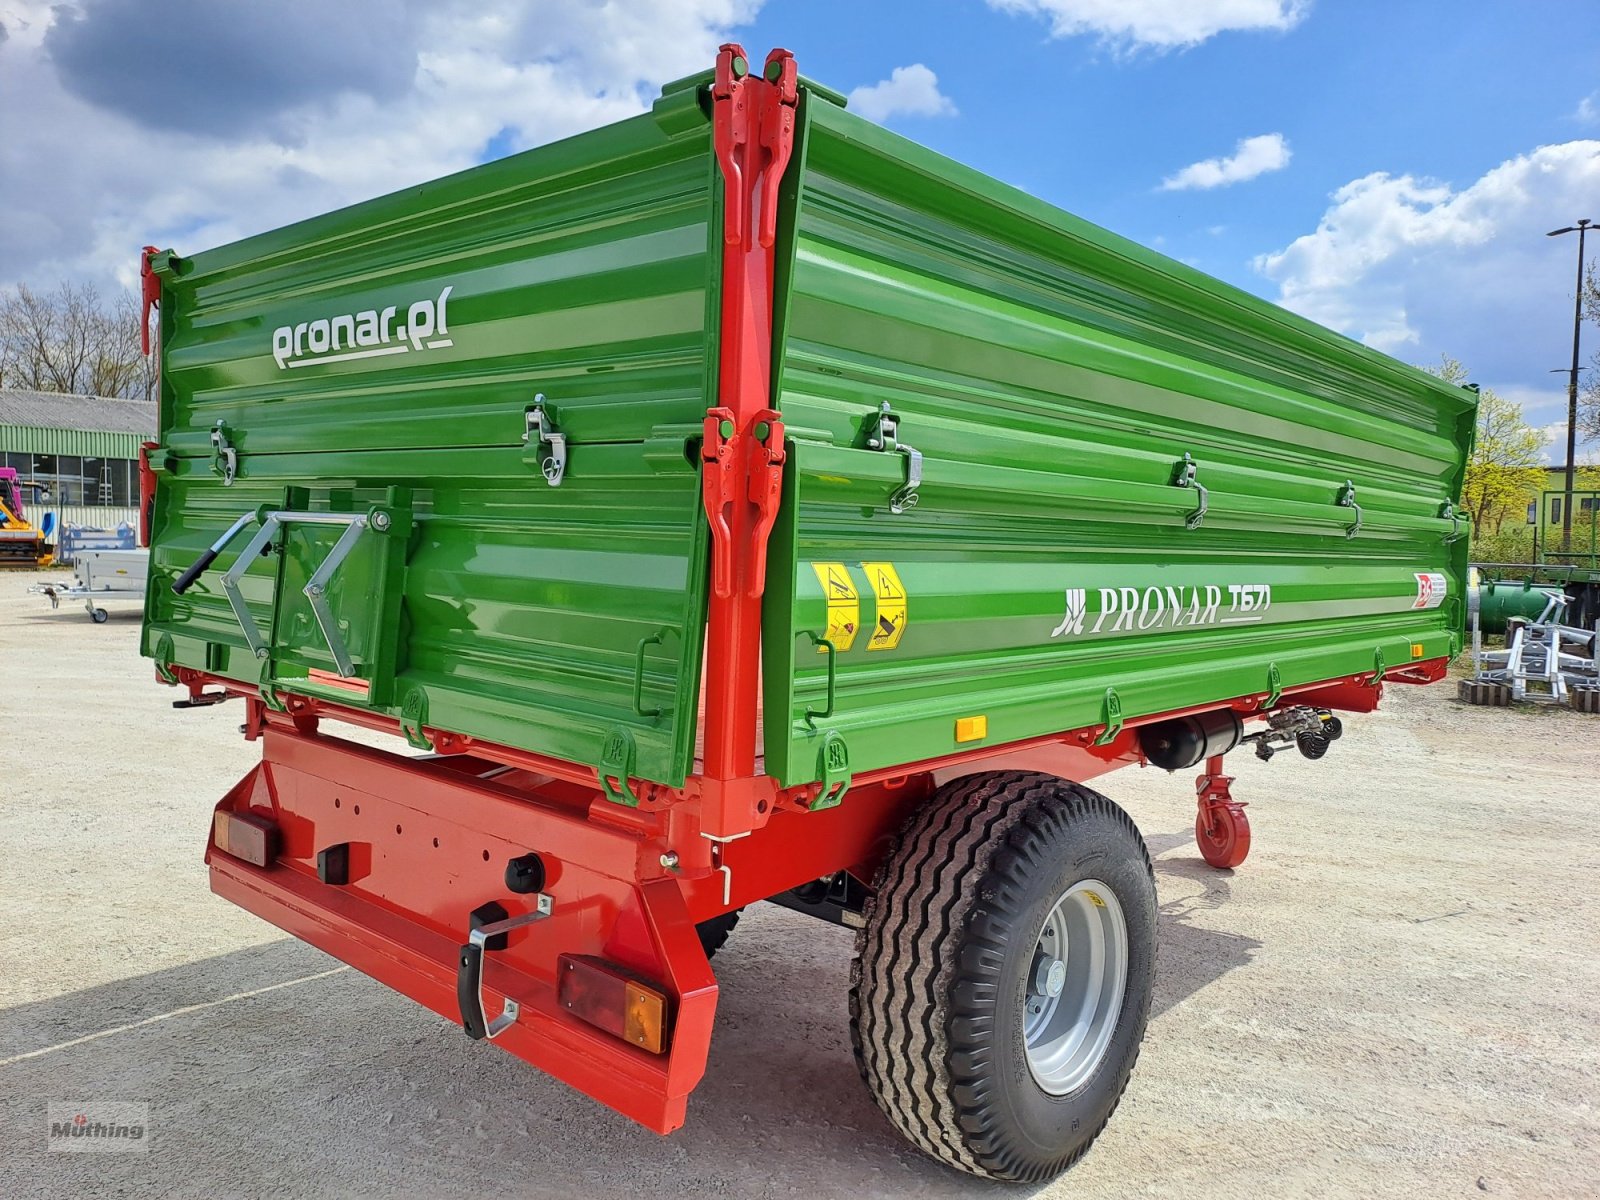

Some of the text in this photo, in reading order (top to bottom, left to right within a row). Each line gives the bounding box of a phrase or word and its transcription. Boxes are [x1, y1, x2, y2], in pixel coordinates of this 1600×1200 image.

[272, 286, 453, 370] pronar.pl
[1088, 584, 1271, 634] PRONAR T671
